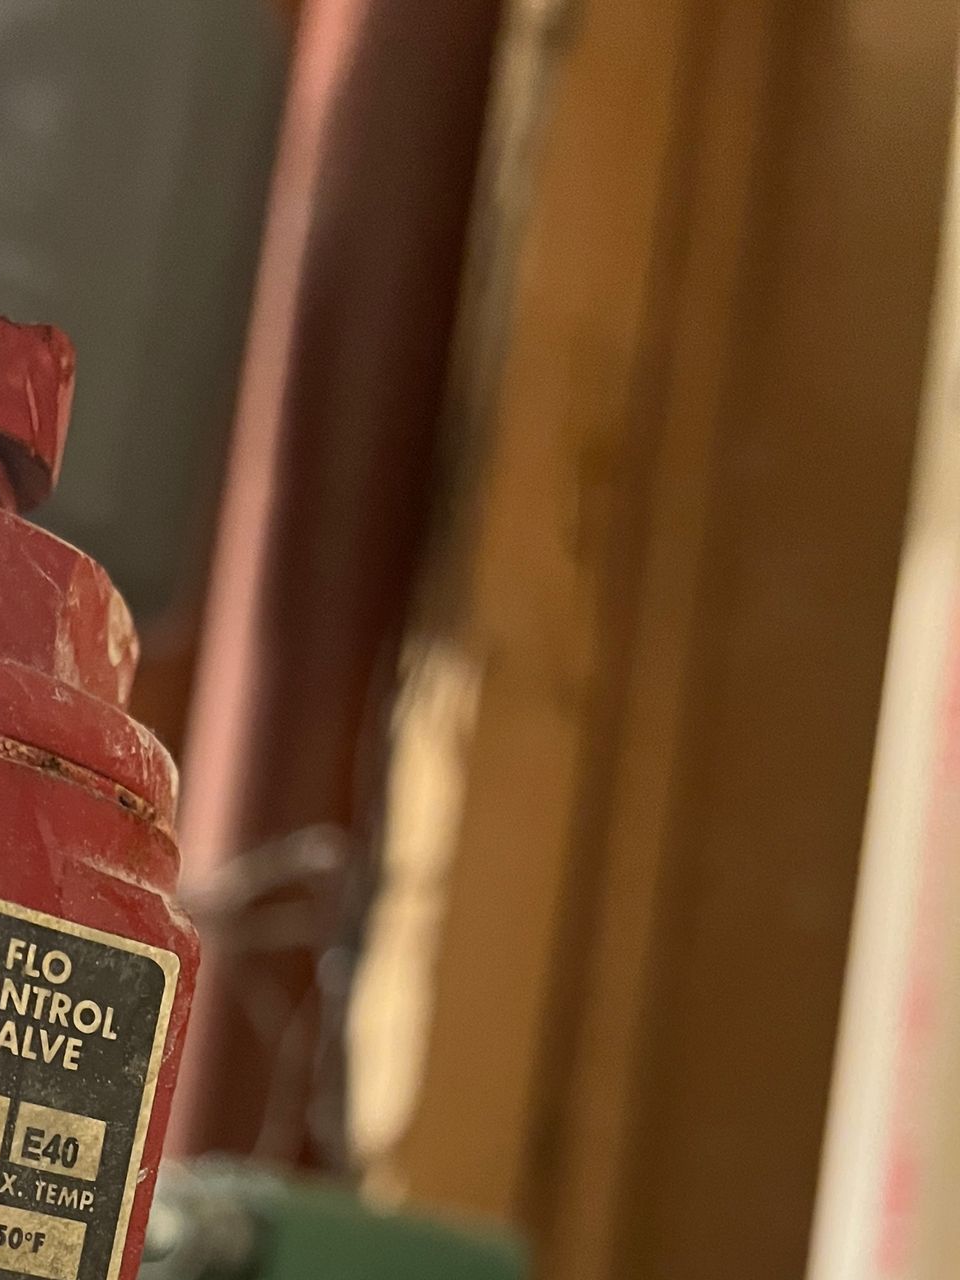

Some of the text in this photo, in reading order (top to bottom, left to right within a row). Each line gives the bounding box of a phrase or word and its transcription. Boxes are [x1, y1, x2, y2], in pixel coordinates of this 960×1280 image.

[6, 938, 72, 984] FLO
[21, 1127, 80, 1168] E40
[35, 1180, 95, 1212] TEMP.
